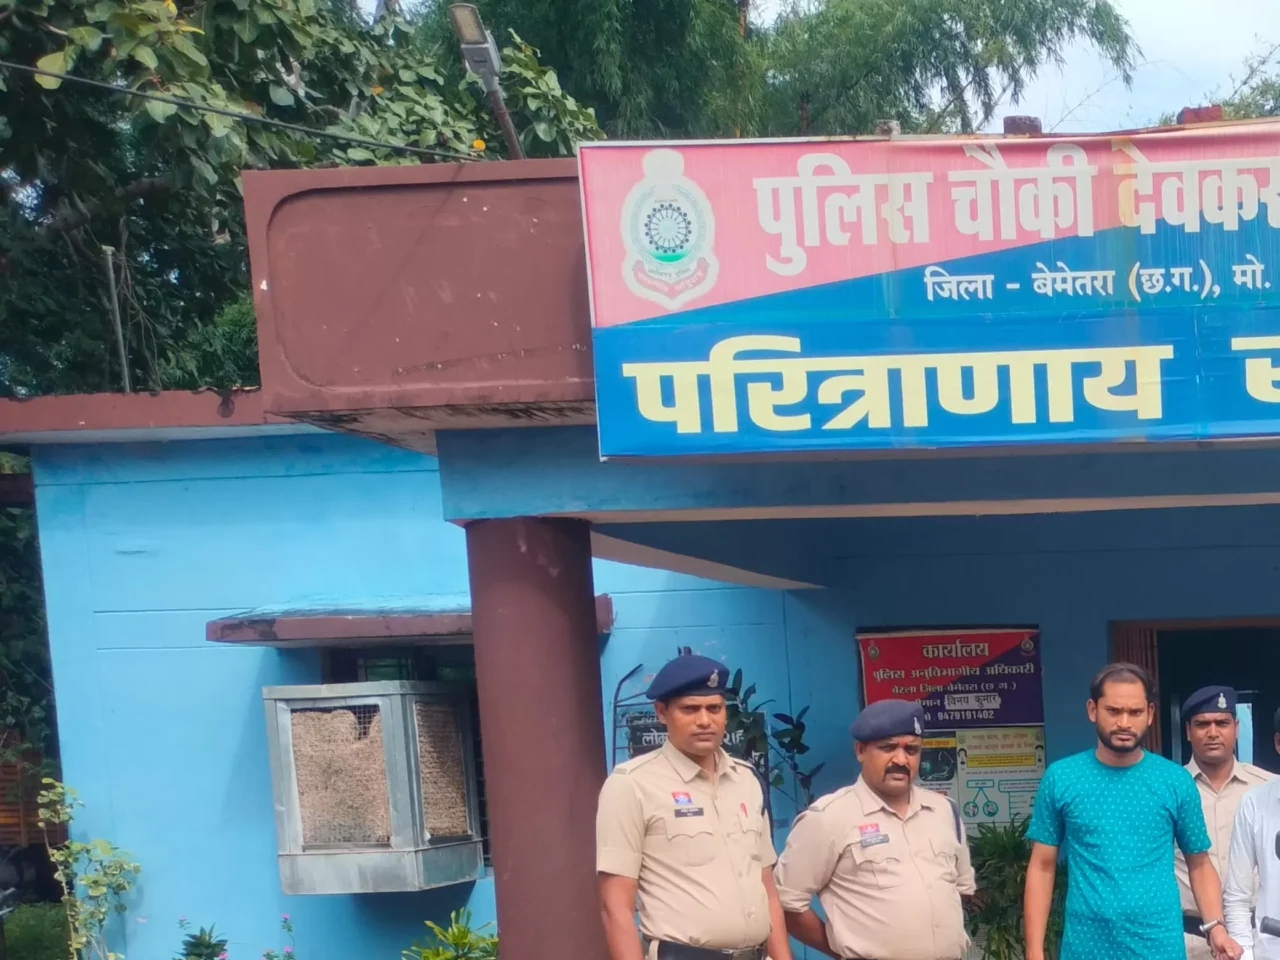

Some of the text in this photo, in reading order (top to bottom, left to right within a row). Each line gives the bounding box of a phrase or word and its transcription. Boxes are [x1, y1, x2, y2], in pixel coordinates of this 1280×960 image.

[752, 153, 933, 275] पुलिस
[948, 143, 1098, 241] चौकी
[924, 265, 994, 301] जिला
[1031, 261, 1115, 297] बेमेतरा
[1232, 254, 1271, 289] मो.
[622, 335, 1174, 434] परित्राणाय
[921, 639, 990, 659] कार्यालय
[872, 668, 906, 683] पुलिस
[984, 662, 1035, 676] अधिकारी
[974, 694, 999, 708] कुमार
[938, 710, 995, 722] 9479191402
